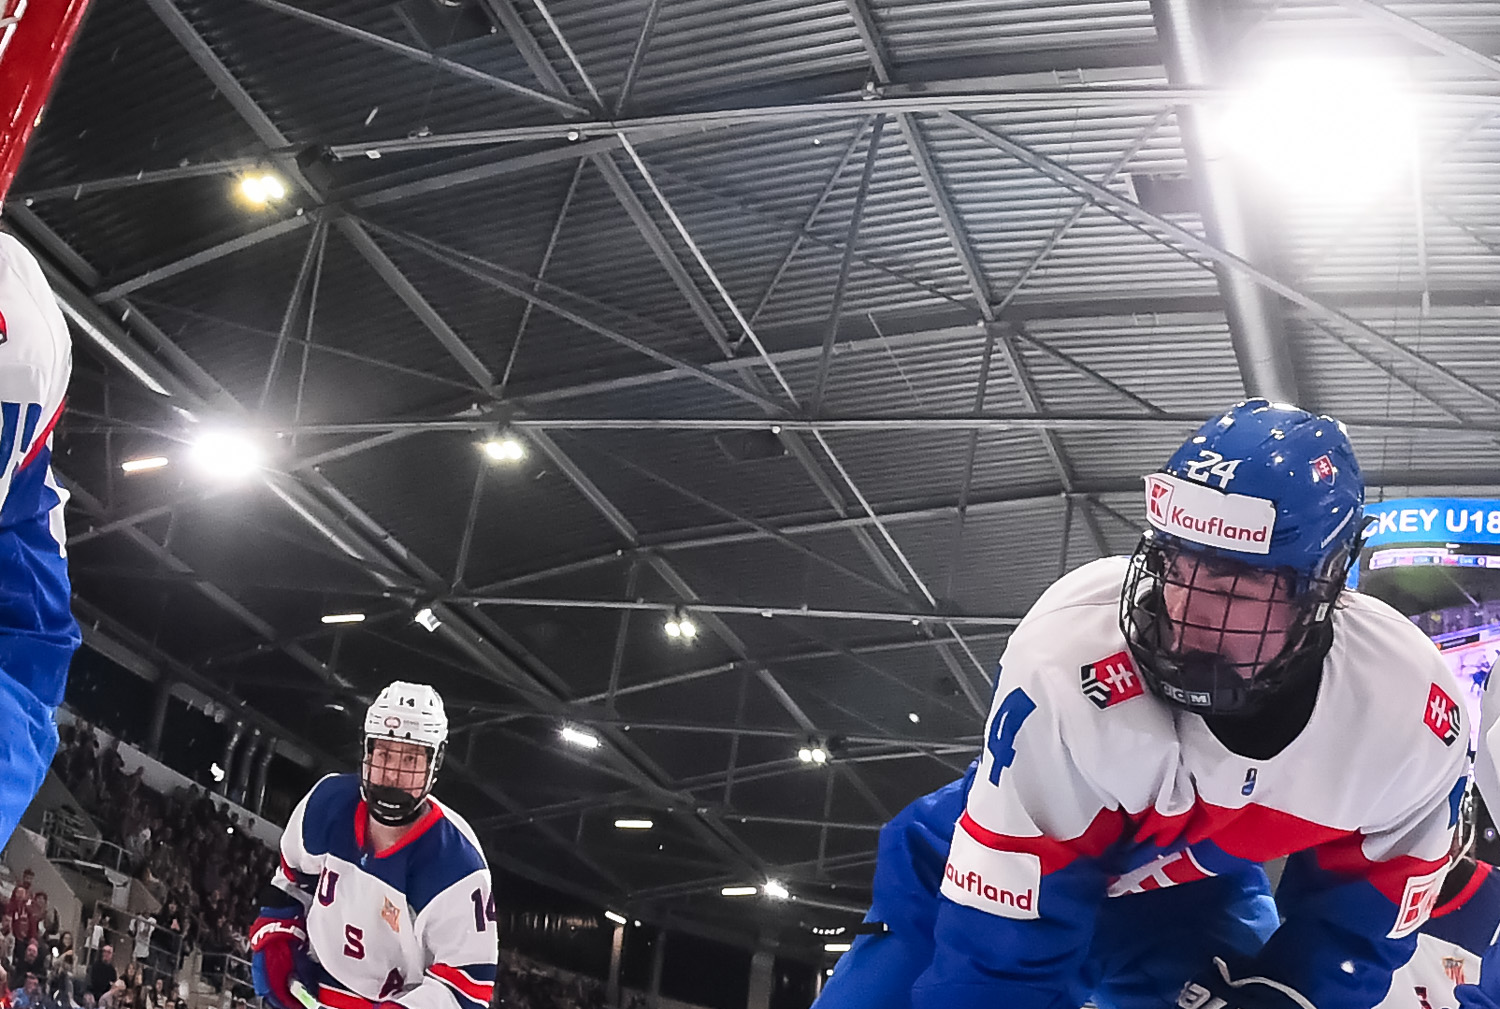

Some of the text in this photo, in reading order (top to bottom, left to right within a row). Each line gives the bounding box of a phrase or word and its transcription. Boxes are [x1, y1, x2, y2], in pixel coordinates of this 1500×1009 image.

[1187, 450, 1243, 489] 24
[1171, 505, 1267, 543] Kaufland
[318, 867, 340, 907] U
[344, 923, 366, 960] S
